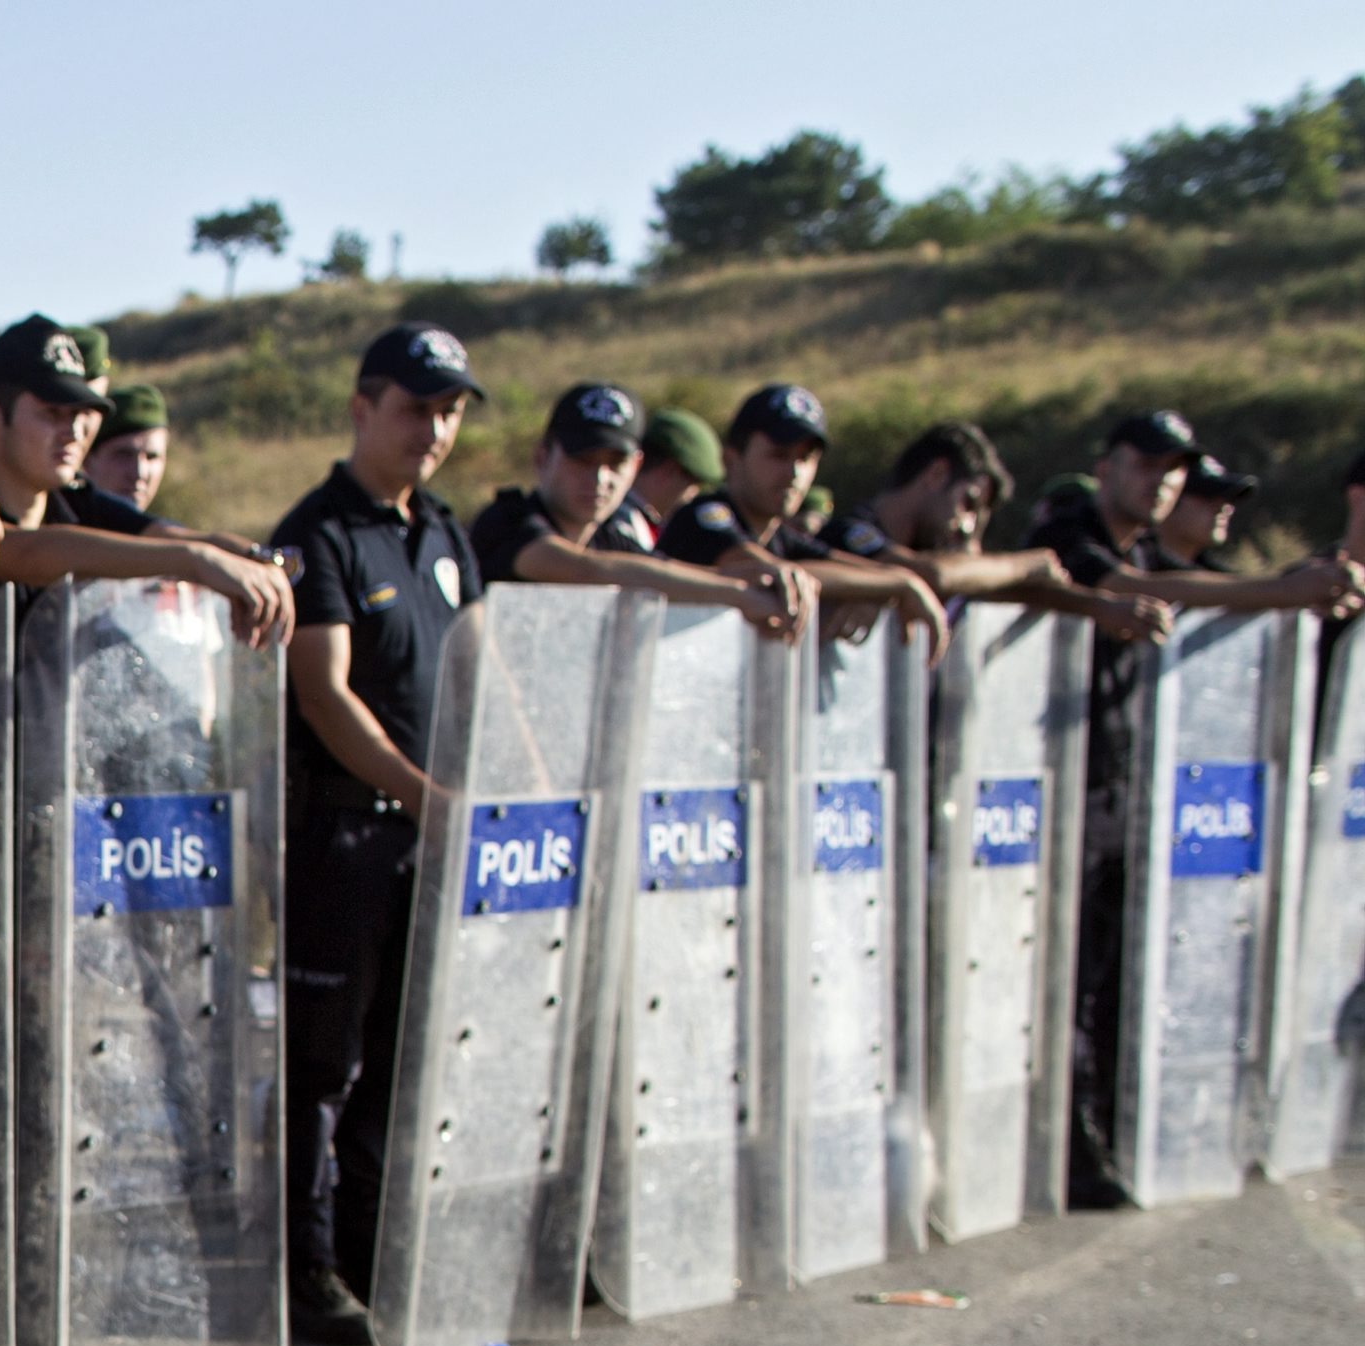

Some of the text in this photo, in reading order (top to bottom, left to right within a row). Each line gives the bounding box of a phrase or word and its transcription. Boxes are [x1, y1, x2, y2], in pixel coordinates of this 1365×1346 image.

[101, 827, 205, 881] POLİS
[477, 828, 572, 887] POLİS
[649, 813, 737, 867] POLİS
